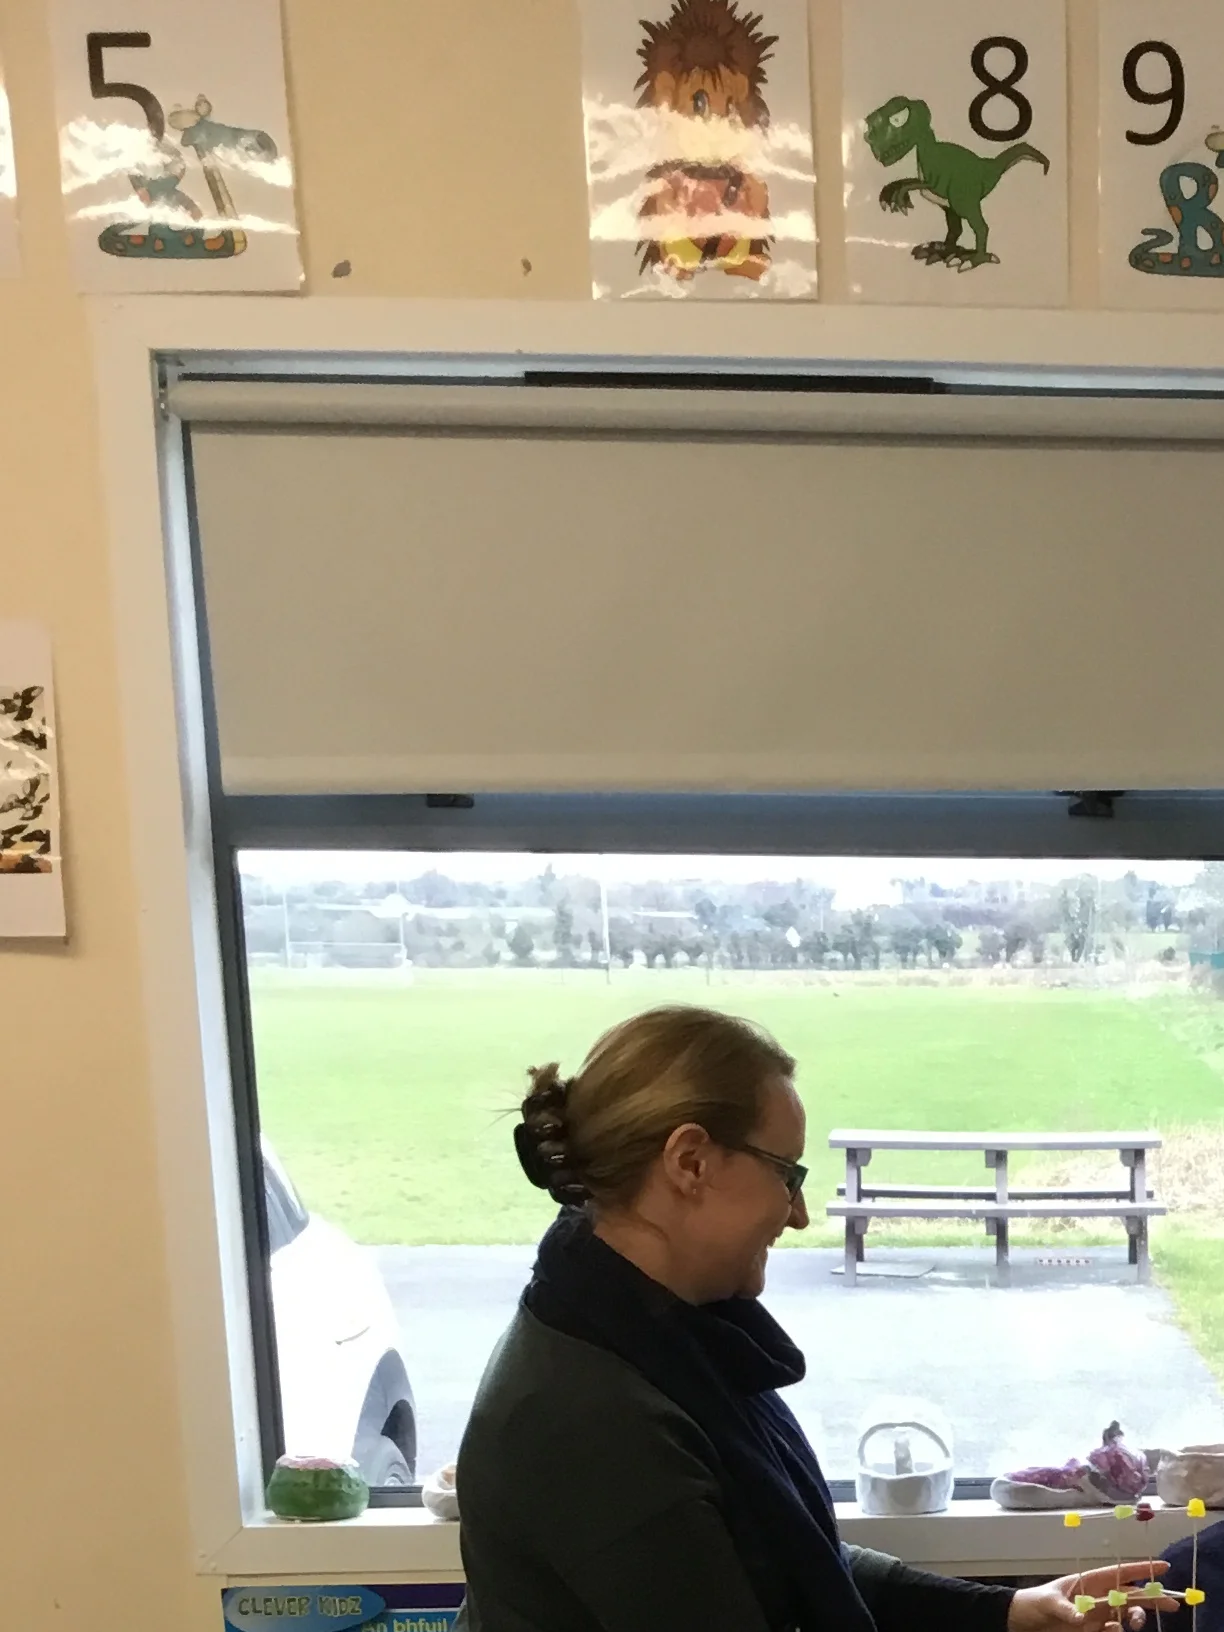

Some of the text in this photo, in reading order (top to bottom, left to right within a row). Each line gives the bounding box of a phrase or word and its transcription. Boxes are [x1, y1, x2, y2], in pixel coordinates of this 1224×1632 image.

[87, 32, 165, 141] 5
[967, 35, 1033, 143] 8
[1121, 39, 1187, 147] 9
[238, 1595, 363, 1616] CLEVER KIDZ
